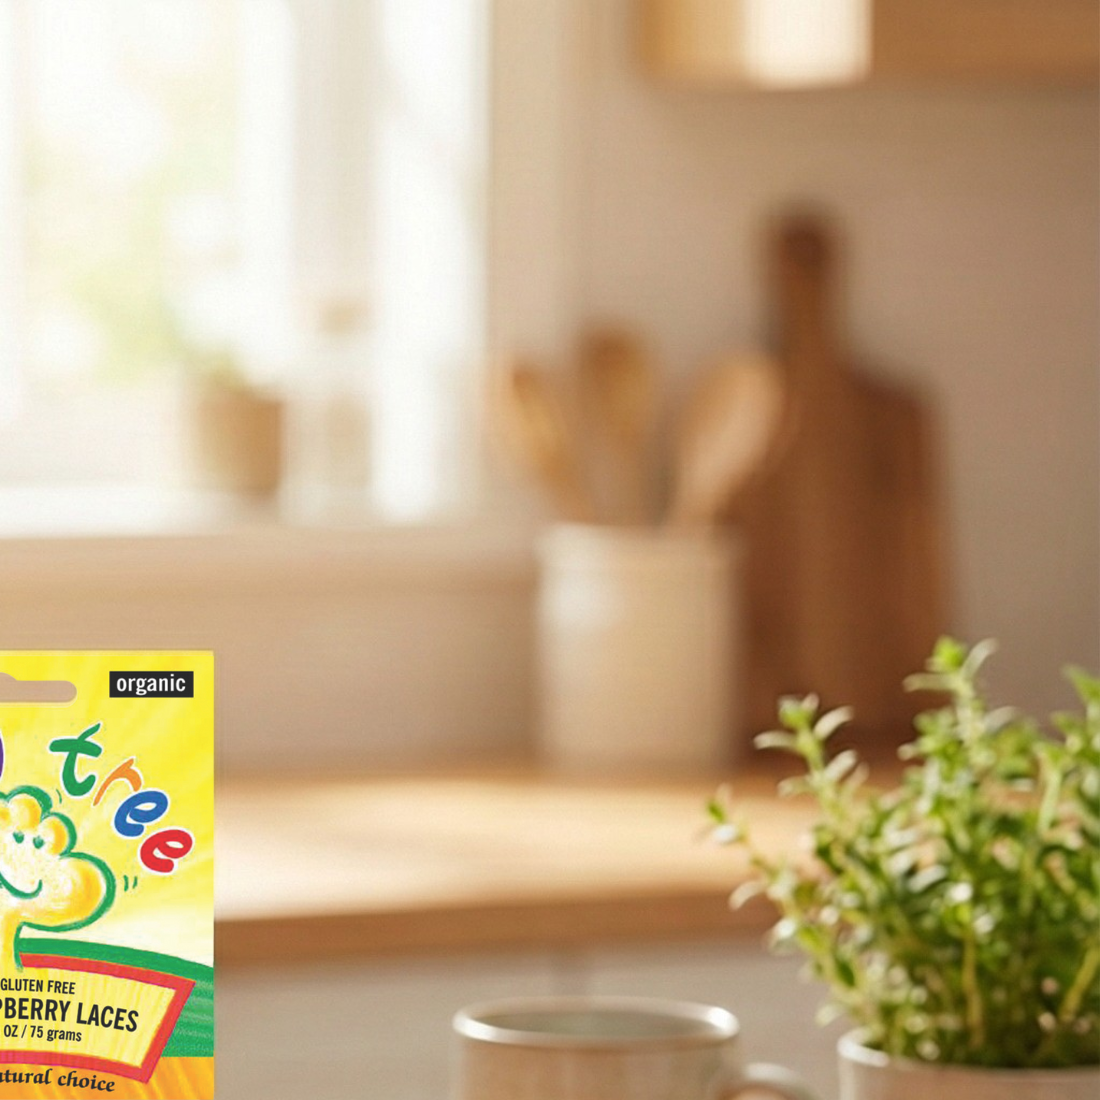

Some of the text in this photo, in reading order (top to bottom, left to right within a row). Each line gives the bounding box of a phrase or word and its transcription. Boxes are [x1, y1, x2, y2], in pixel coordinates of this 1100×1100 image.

[115, 673, 186, 695] organic
[48, 722, 193, 873] tree
[0, 978, 44, 994] GLUTEN
[47, 980, 76, 995] FREE
[76, 1002, 139, 1032] LACES
[4, 1025, 18, 1038] OZ
[30, 1025, 44, 1039] 75
[47, 1029, 82, 1043] grams
[57, 1070, 116, 1093] choice
